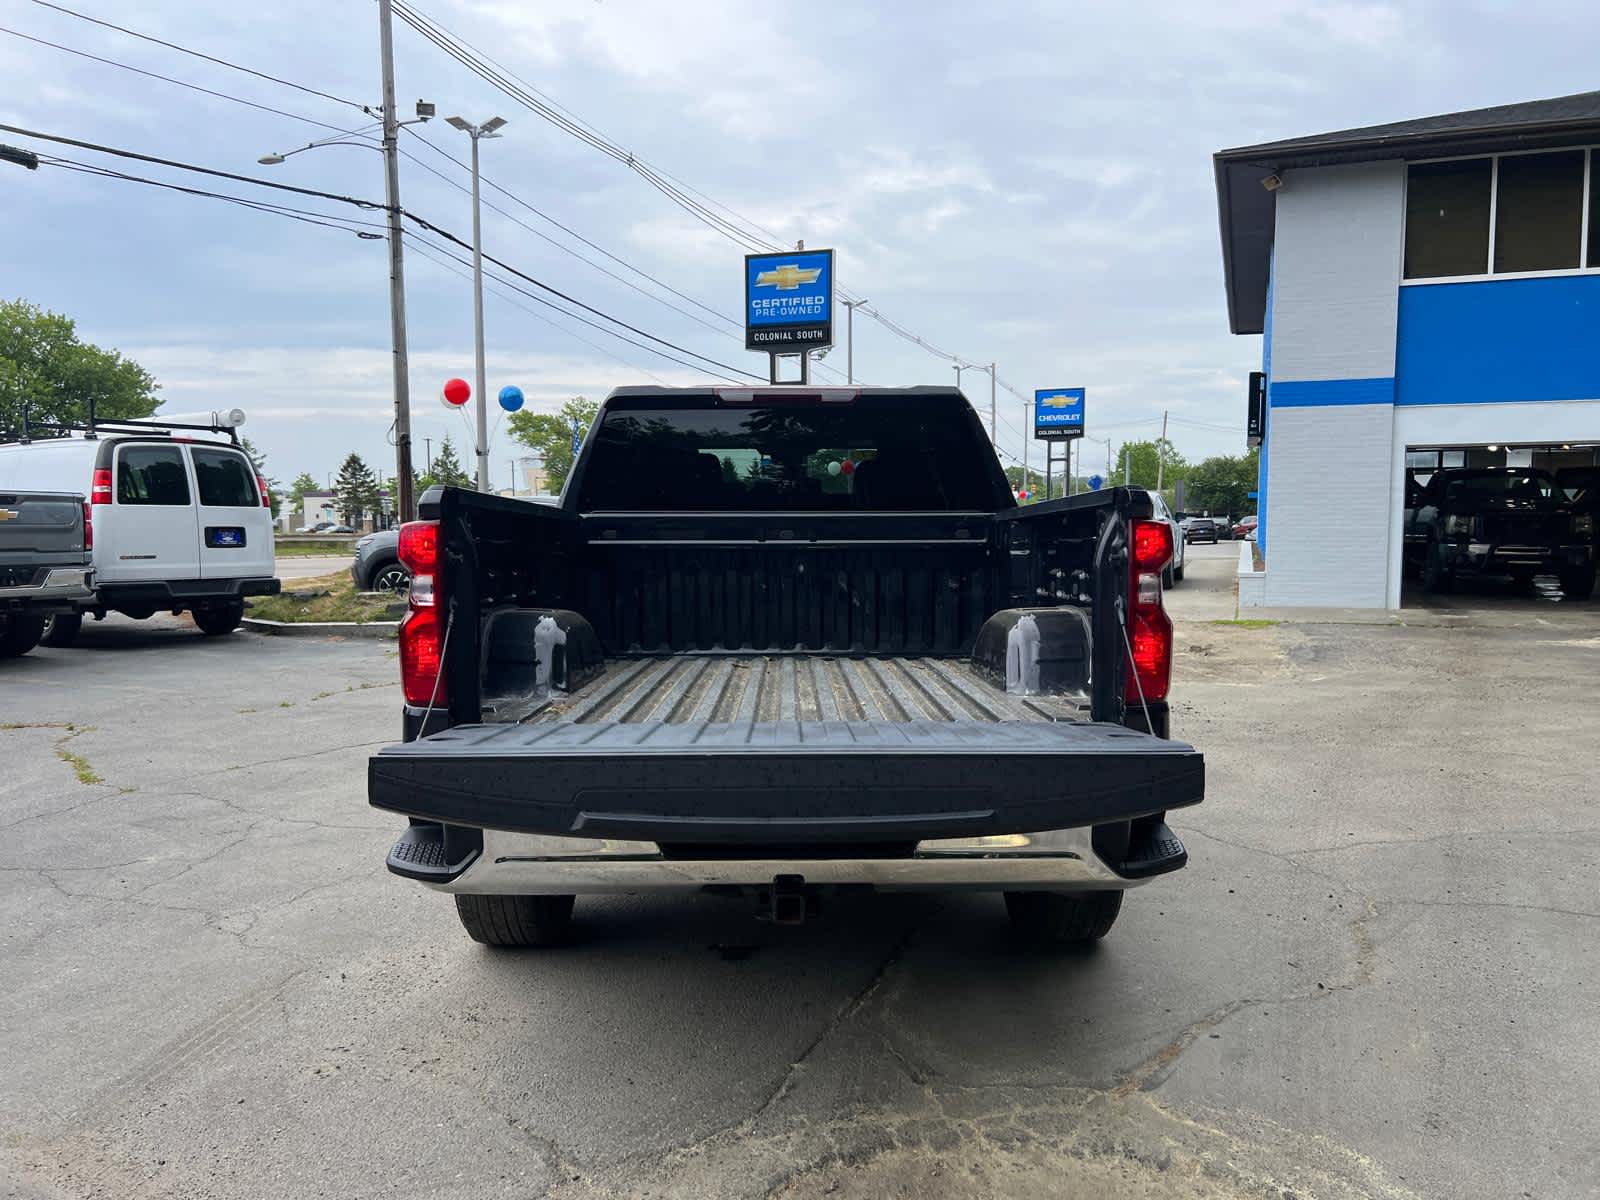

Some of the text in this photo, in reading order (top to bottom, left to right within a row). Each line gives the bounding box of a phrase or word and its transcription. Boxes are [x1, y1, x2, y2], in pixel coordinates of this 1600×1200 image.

[752, 296, 825, 308] CERTIFIED
[756, 306, 821, 316] PRE-OWNED
[754, 330, 823, 341] COLONIAL SOUTH
